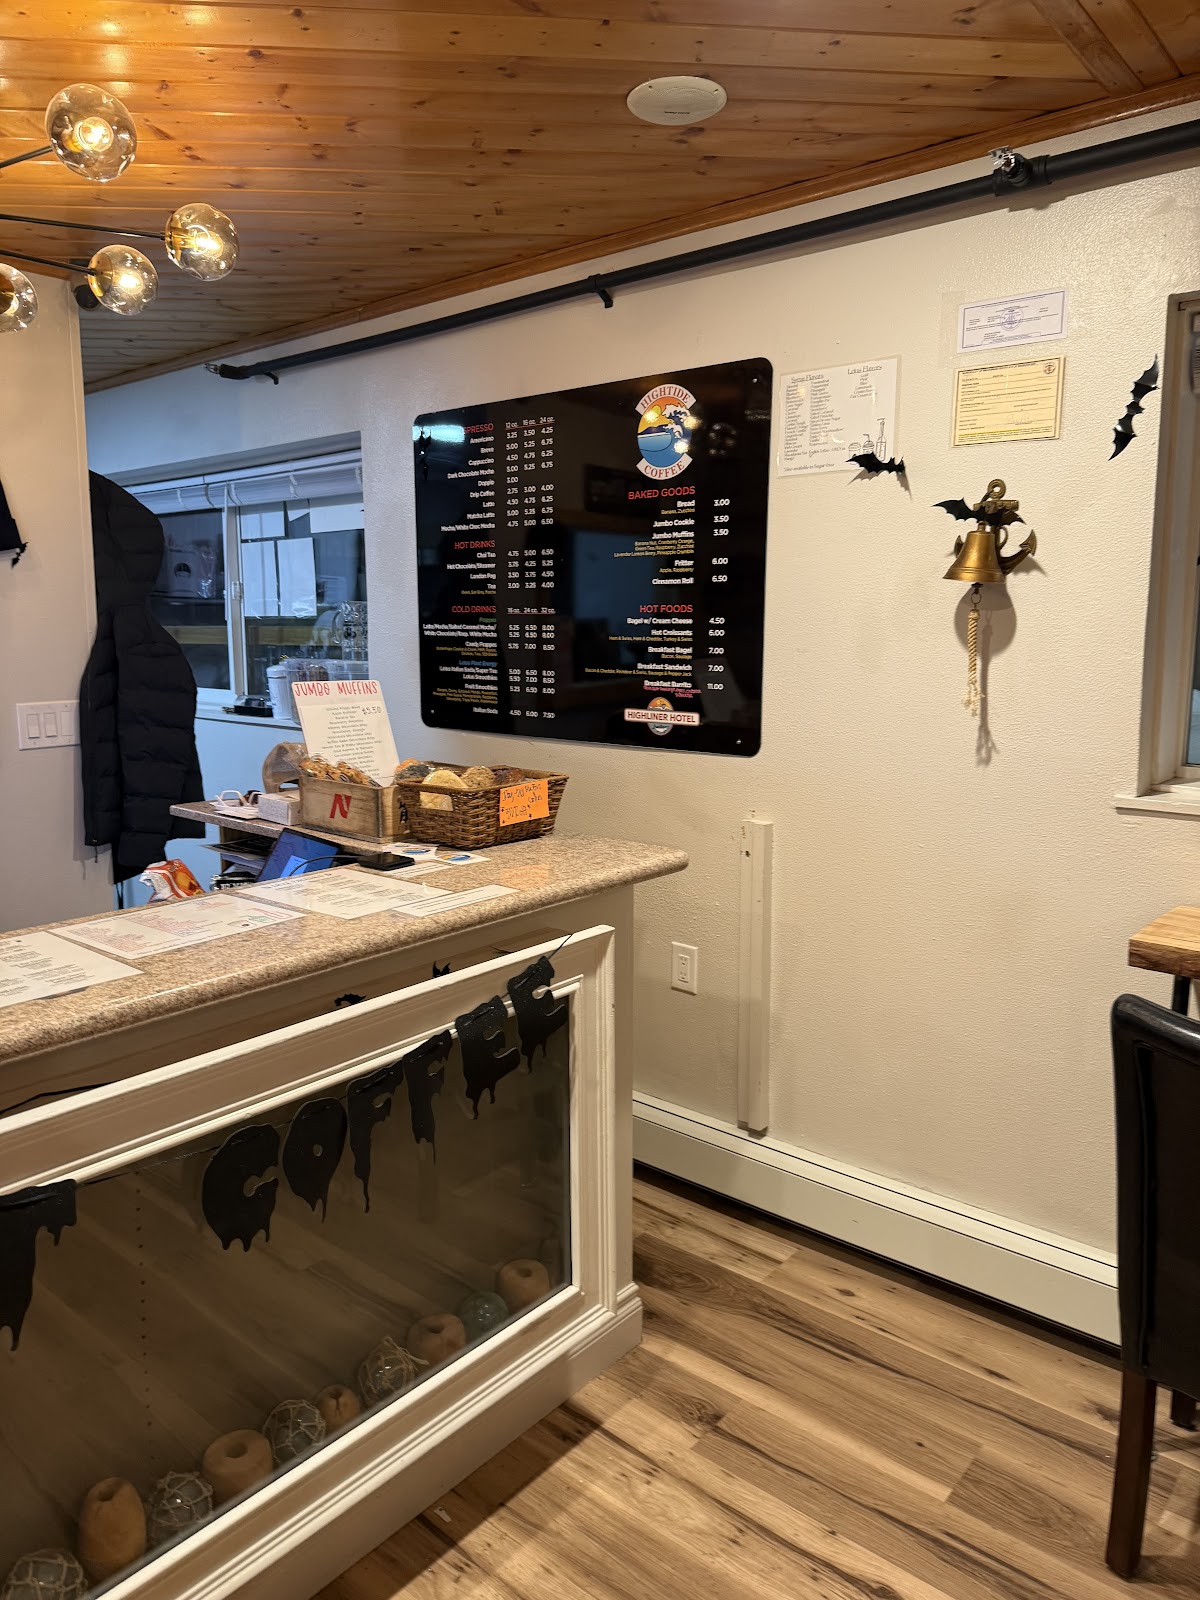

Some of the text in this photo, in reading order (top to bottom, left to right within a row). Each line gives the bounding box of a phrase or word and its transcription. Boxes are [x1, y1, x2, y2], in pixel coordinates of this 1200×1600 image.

[641, 386, 690, 409] HIGHTIDE
[464, 423, 494, 434] SPRESSO
[507, 431, 517, 439] 3.25
[524, 429, 535, 437] 3.50
[541, 426, 553, 434] 4.25
[524, 440, 535, 448] 5.25
[524, 451, 535, 459] 4.75
[507, 465, 518, 473] 5.00
[524, 463, 535, 471] 5.25
[644, 461, 684, 478] COFFEE
[507, 476, 518, 484] 3.00
[524, 485, 536, 493] 3.00
[628, 486, 696, 500] BAKED GOODS
[524, 496, 536, 504] 4.75
[714, 499, 730, 507] 3.00
[674, 518, 695, 526] Cookie
[714, 515, 730, 523] 3.50
[713, 528, 729, 536] 3.50
[454, 540, 496, 549] HOT DRINKS
[452, 605, 470, 613] COLD
[639, 605, 693, 613] HOT FOODS
[708, 664, 724, 672] 7.00
[294, 681, 378, 697] JUMBO MUFFINS
[628, 711, 696, 723] HIGHLINER HOTEL
[202, 957, 570, 1253] COFFEE
